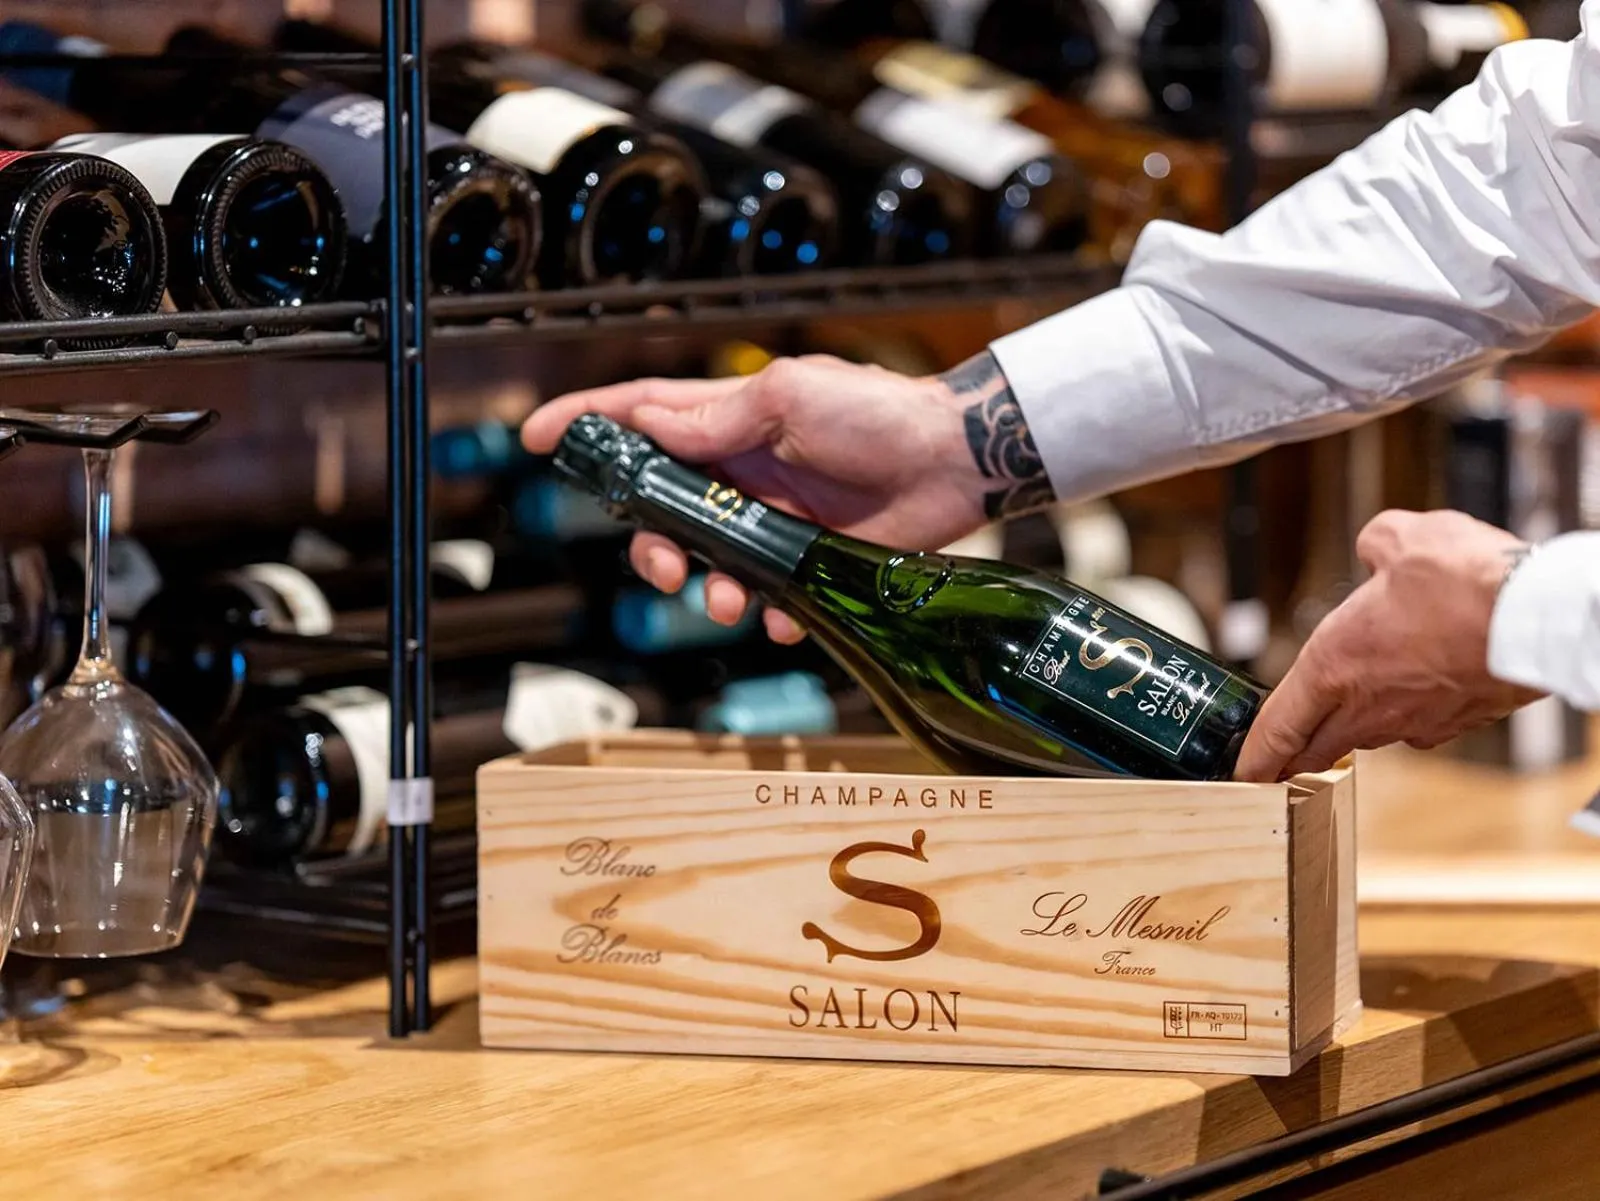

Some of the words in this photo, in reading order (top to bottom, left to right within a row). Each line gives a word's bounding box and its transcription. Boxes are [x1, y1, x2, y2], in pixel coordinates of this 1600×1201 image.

[1029, 596, 1090, 673] CHAMPAGNE
[1043, 650, 1071, 685] Brut
[1078, 620, 1153, 699] S
[1137, 654, 1190, 717] SALON
[1161, 694, 1178, 716] BLANC
[755, 784, 993, 809] CHAMPAGNE
[560, 836, 656, 877] Blanc
[591, 894, 621, 920] de
[801, 829, 942, 963] S
[1020, 891, 1088, 937] Le
[1086, 895, 1231, 941] Mesnil
[556, 923, 662, 964] Blancs
[1094, 950, 1156, 976] France
[788, 985, 961, 1032] SALON
